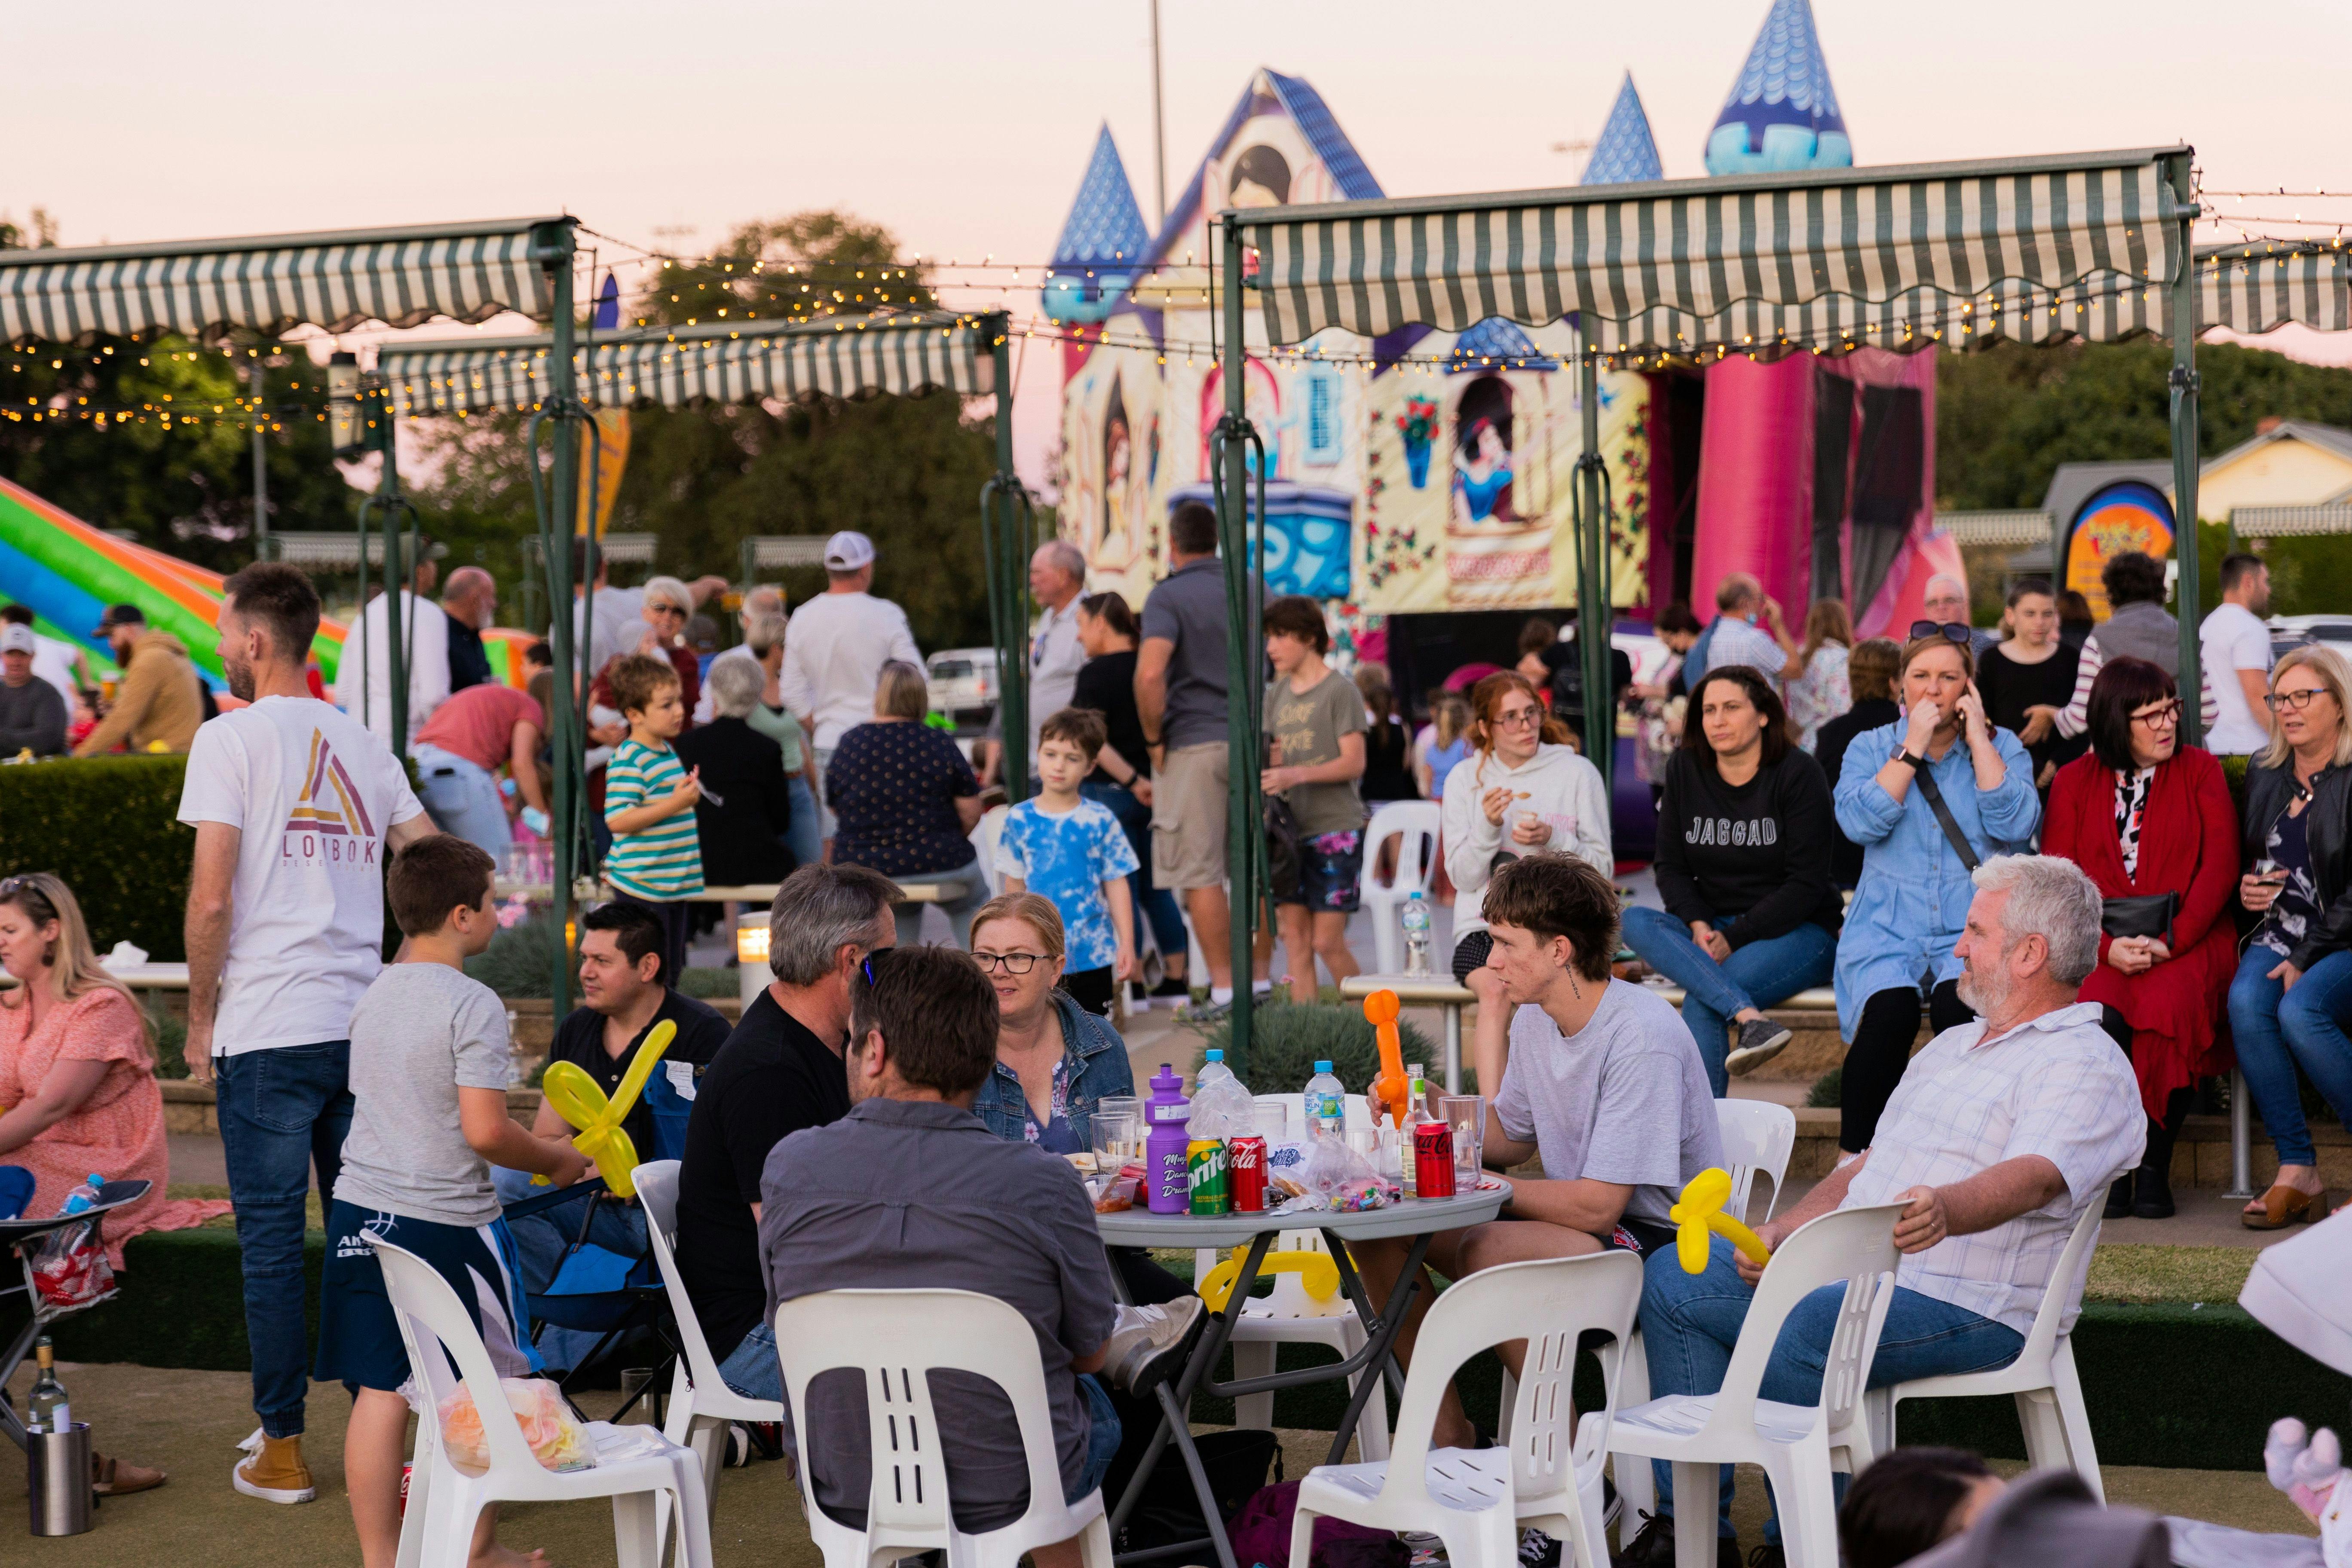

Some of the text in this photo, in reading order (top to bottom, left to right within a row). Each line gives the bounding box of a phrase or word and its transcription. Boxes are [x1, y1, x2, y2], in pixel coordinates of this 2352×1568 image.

[1279, 728, 1316, 755] KATE
[1686, 817, 1777, 846] JAGGAD
[283, 835, 376, 864] LOBOK
[1273, 1157, 1292, 1165] TAILS
[1275, 1149, 1296, 1159] PIGGY
[1188, 1149, 1226, 1201] prite
[1161, 1185, 1189, 1197] Dram
